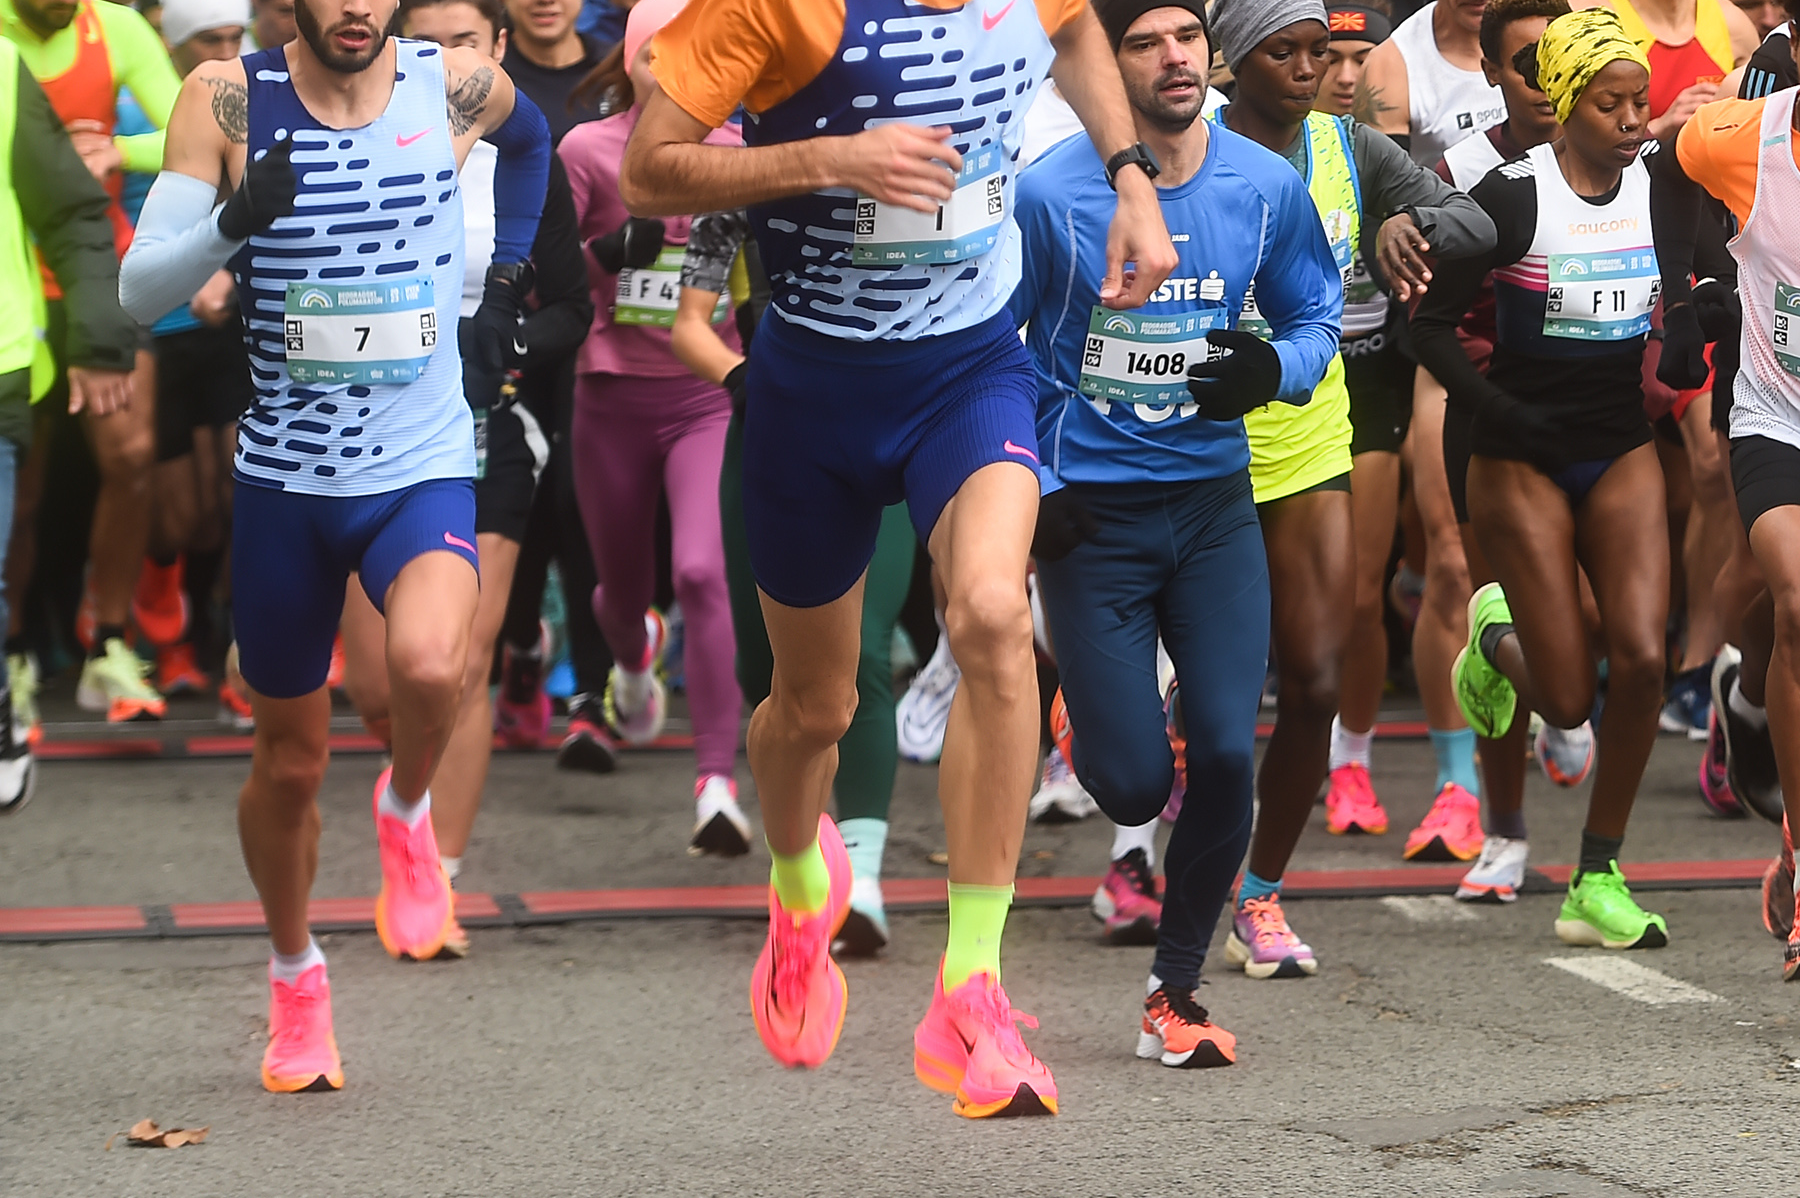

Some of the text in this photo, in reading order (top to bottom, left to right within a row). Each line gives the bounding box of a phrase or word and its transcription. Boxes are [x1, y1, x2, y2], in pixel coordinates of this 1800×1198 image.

[1568, 217, 1638, 235] saucony
[640, 278, 651, 298] F
[1145, 278, 1198, 302] STE
[1593, 289, 1625, 314] F 11
[354, 327, 370, 352] 7
[317, 369, 335, 378] IDEA
[1127, 352, 1186, 376] 1408
[1108, 386, 1126, 397] IDEA
